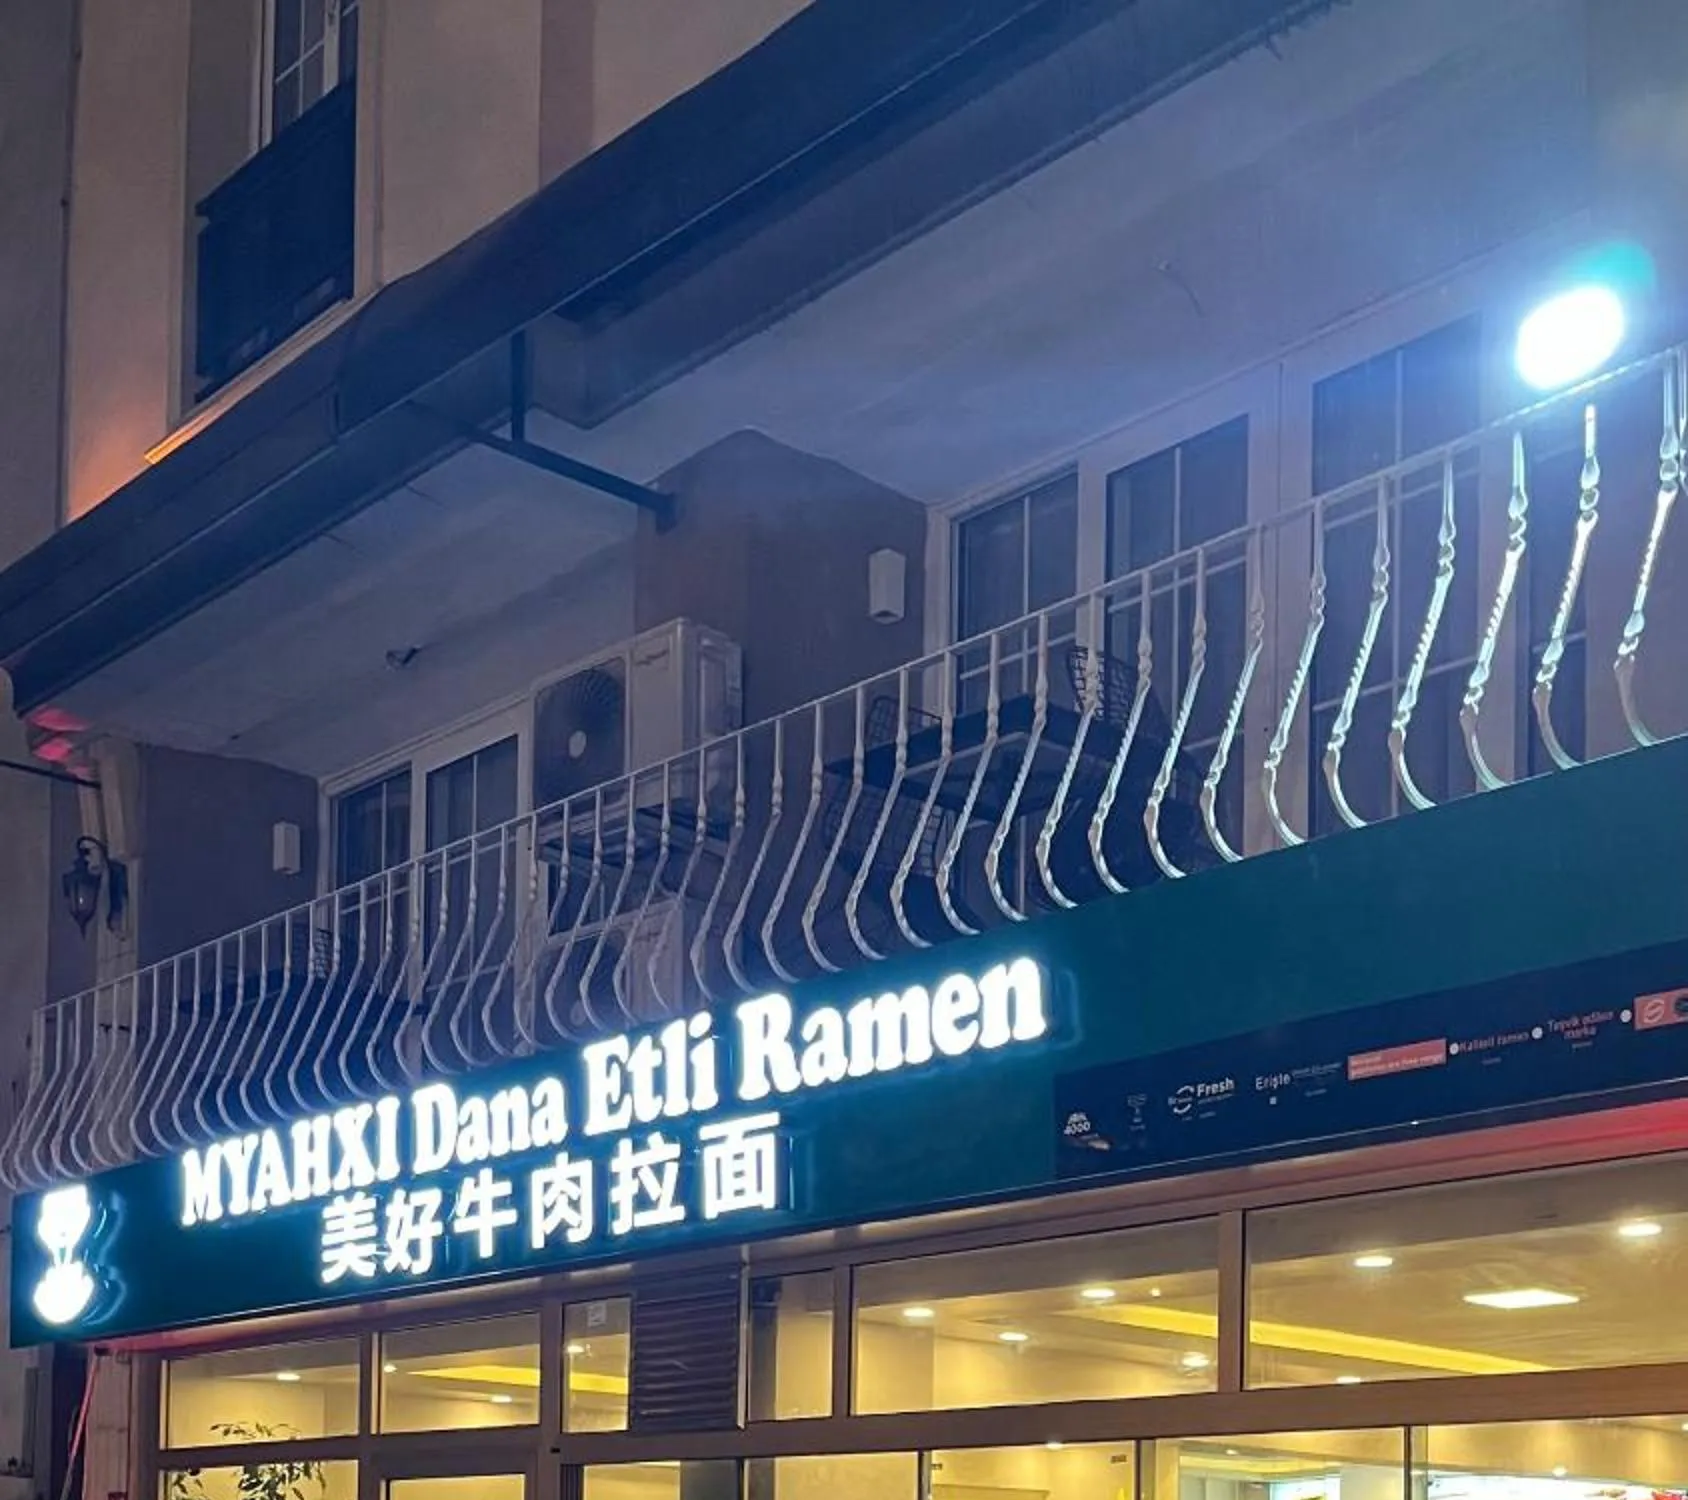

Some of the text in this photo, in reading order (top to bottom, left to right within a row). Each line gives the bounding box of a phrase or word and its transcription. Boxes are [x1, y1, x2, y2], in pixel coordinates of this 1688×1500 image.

[181, 956, 1048, 1227] MYAHXI Dana Etli Ramen
[1196, 1076, 1235, 1097] Fresh
[321, 1111, 781, 1284] 美好牛肉拉面
